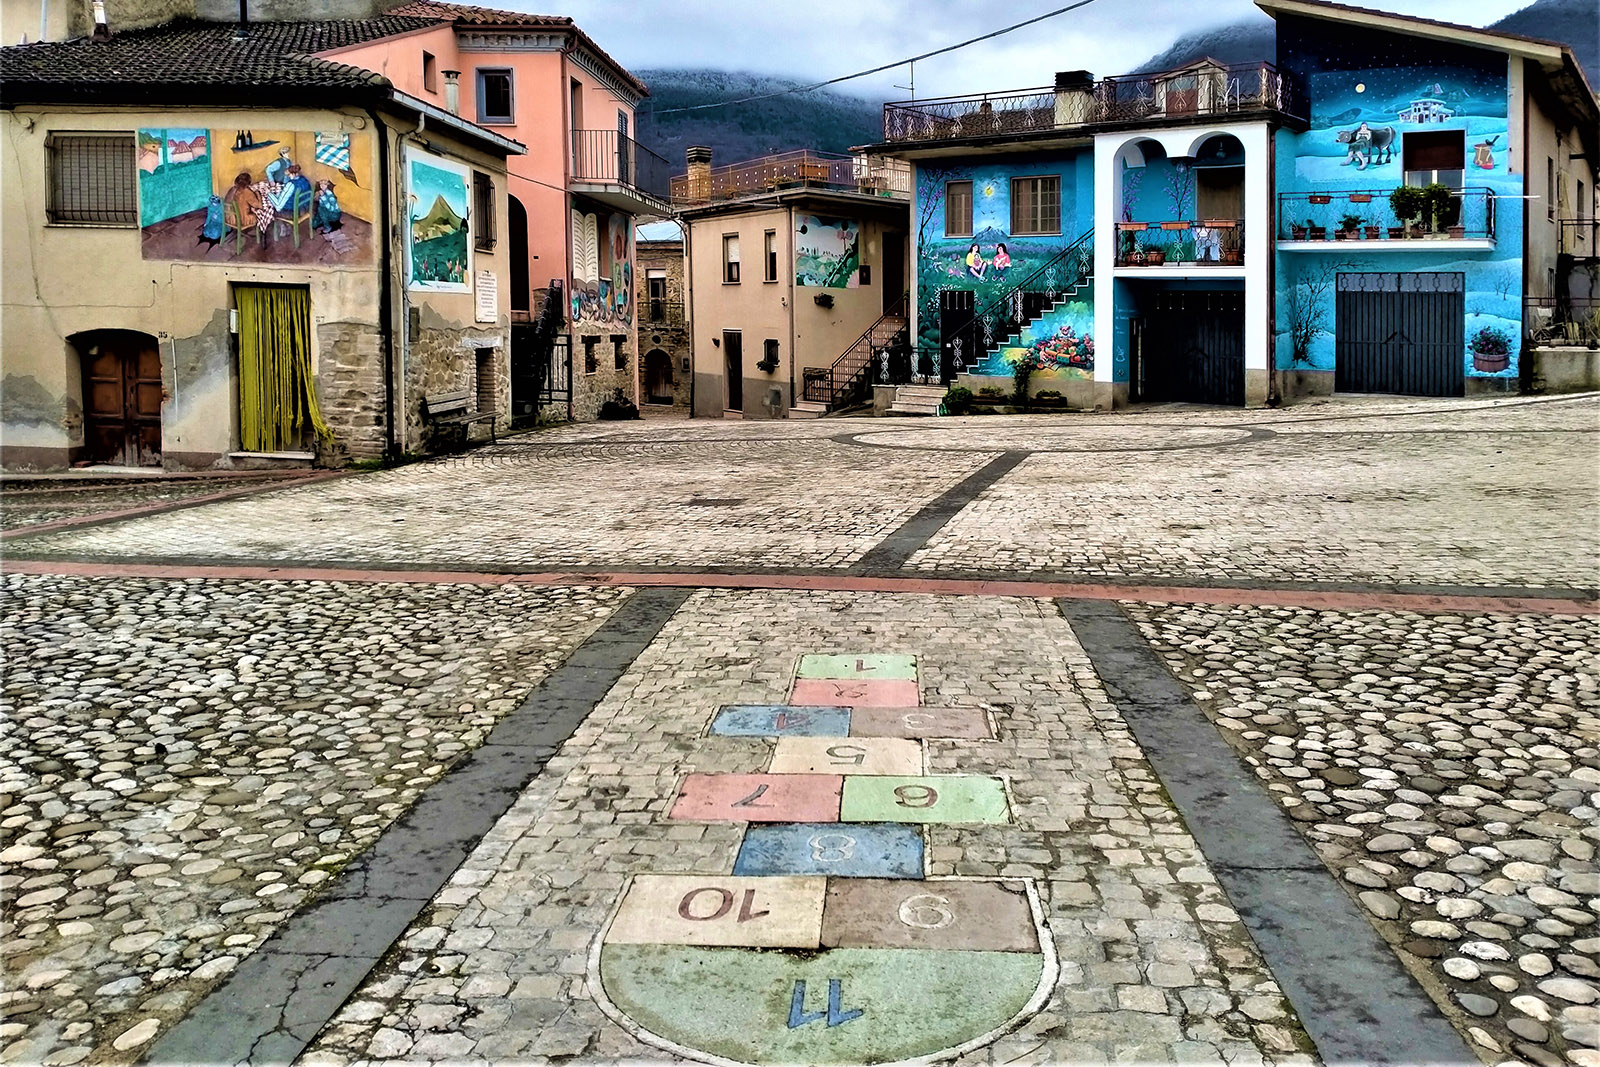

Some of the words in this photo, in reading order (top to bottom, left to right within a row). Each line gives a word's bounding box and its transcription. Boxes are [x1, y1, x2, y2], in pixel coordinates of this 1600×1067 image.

[855, 659, 877, 672] 1
[833, 683, 868, 698] 2
[775, 713, 809, 730] 4
[902, 713, 935, 730] 3
[826, 745, 867, 765] 5
[731, 784, 775, 807] 7
[893, 784, 938, 808] 6
[809, 833, 857, 862] 8
[678, 887, 770, 923] 10
[898, 894, 954, 929] 9
[786, 979, 864, 1029] 11
